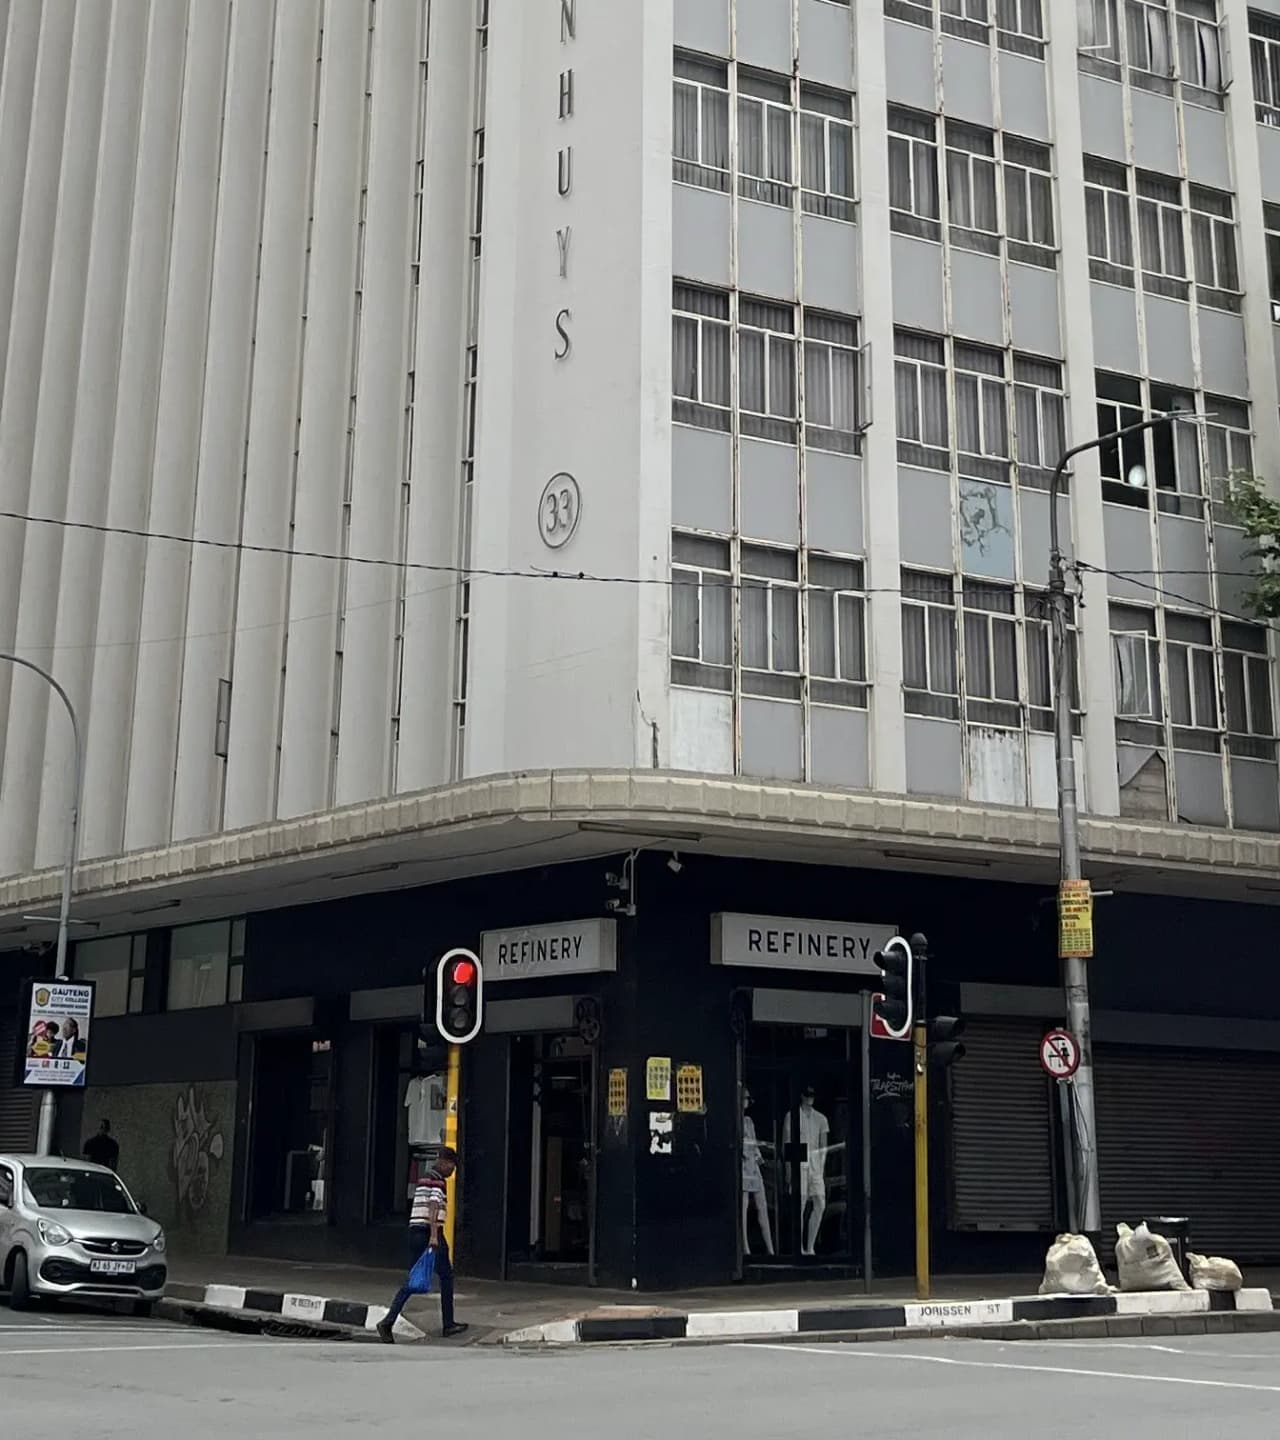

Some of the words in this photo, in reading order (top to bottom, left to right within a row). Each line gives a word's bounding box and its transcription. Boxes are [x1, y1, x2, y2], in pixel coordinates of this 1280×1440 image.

[545, 487, 572, 534] 33
[498, 935, 583, 966] REFINERY
[747, 929, 872, 959] REFINERY
[52, 988, 90, 997] GAUTENG
[920, 1305, 972, 1317] JORISSEN
[987, 1303, 1001, 1314] ST
